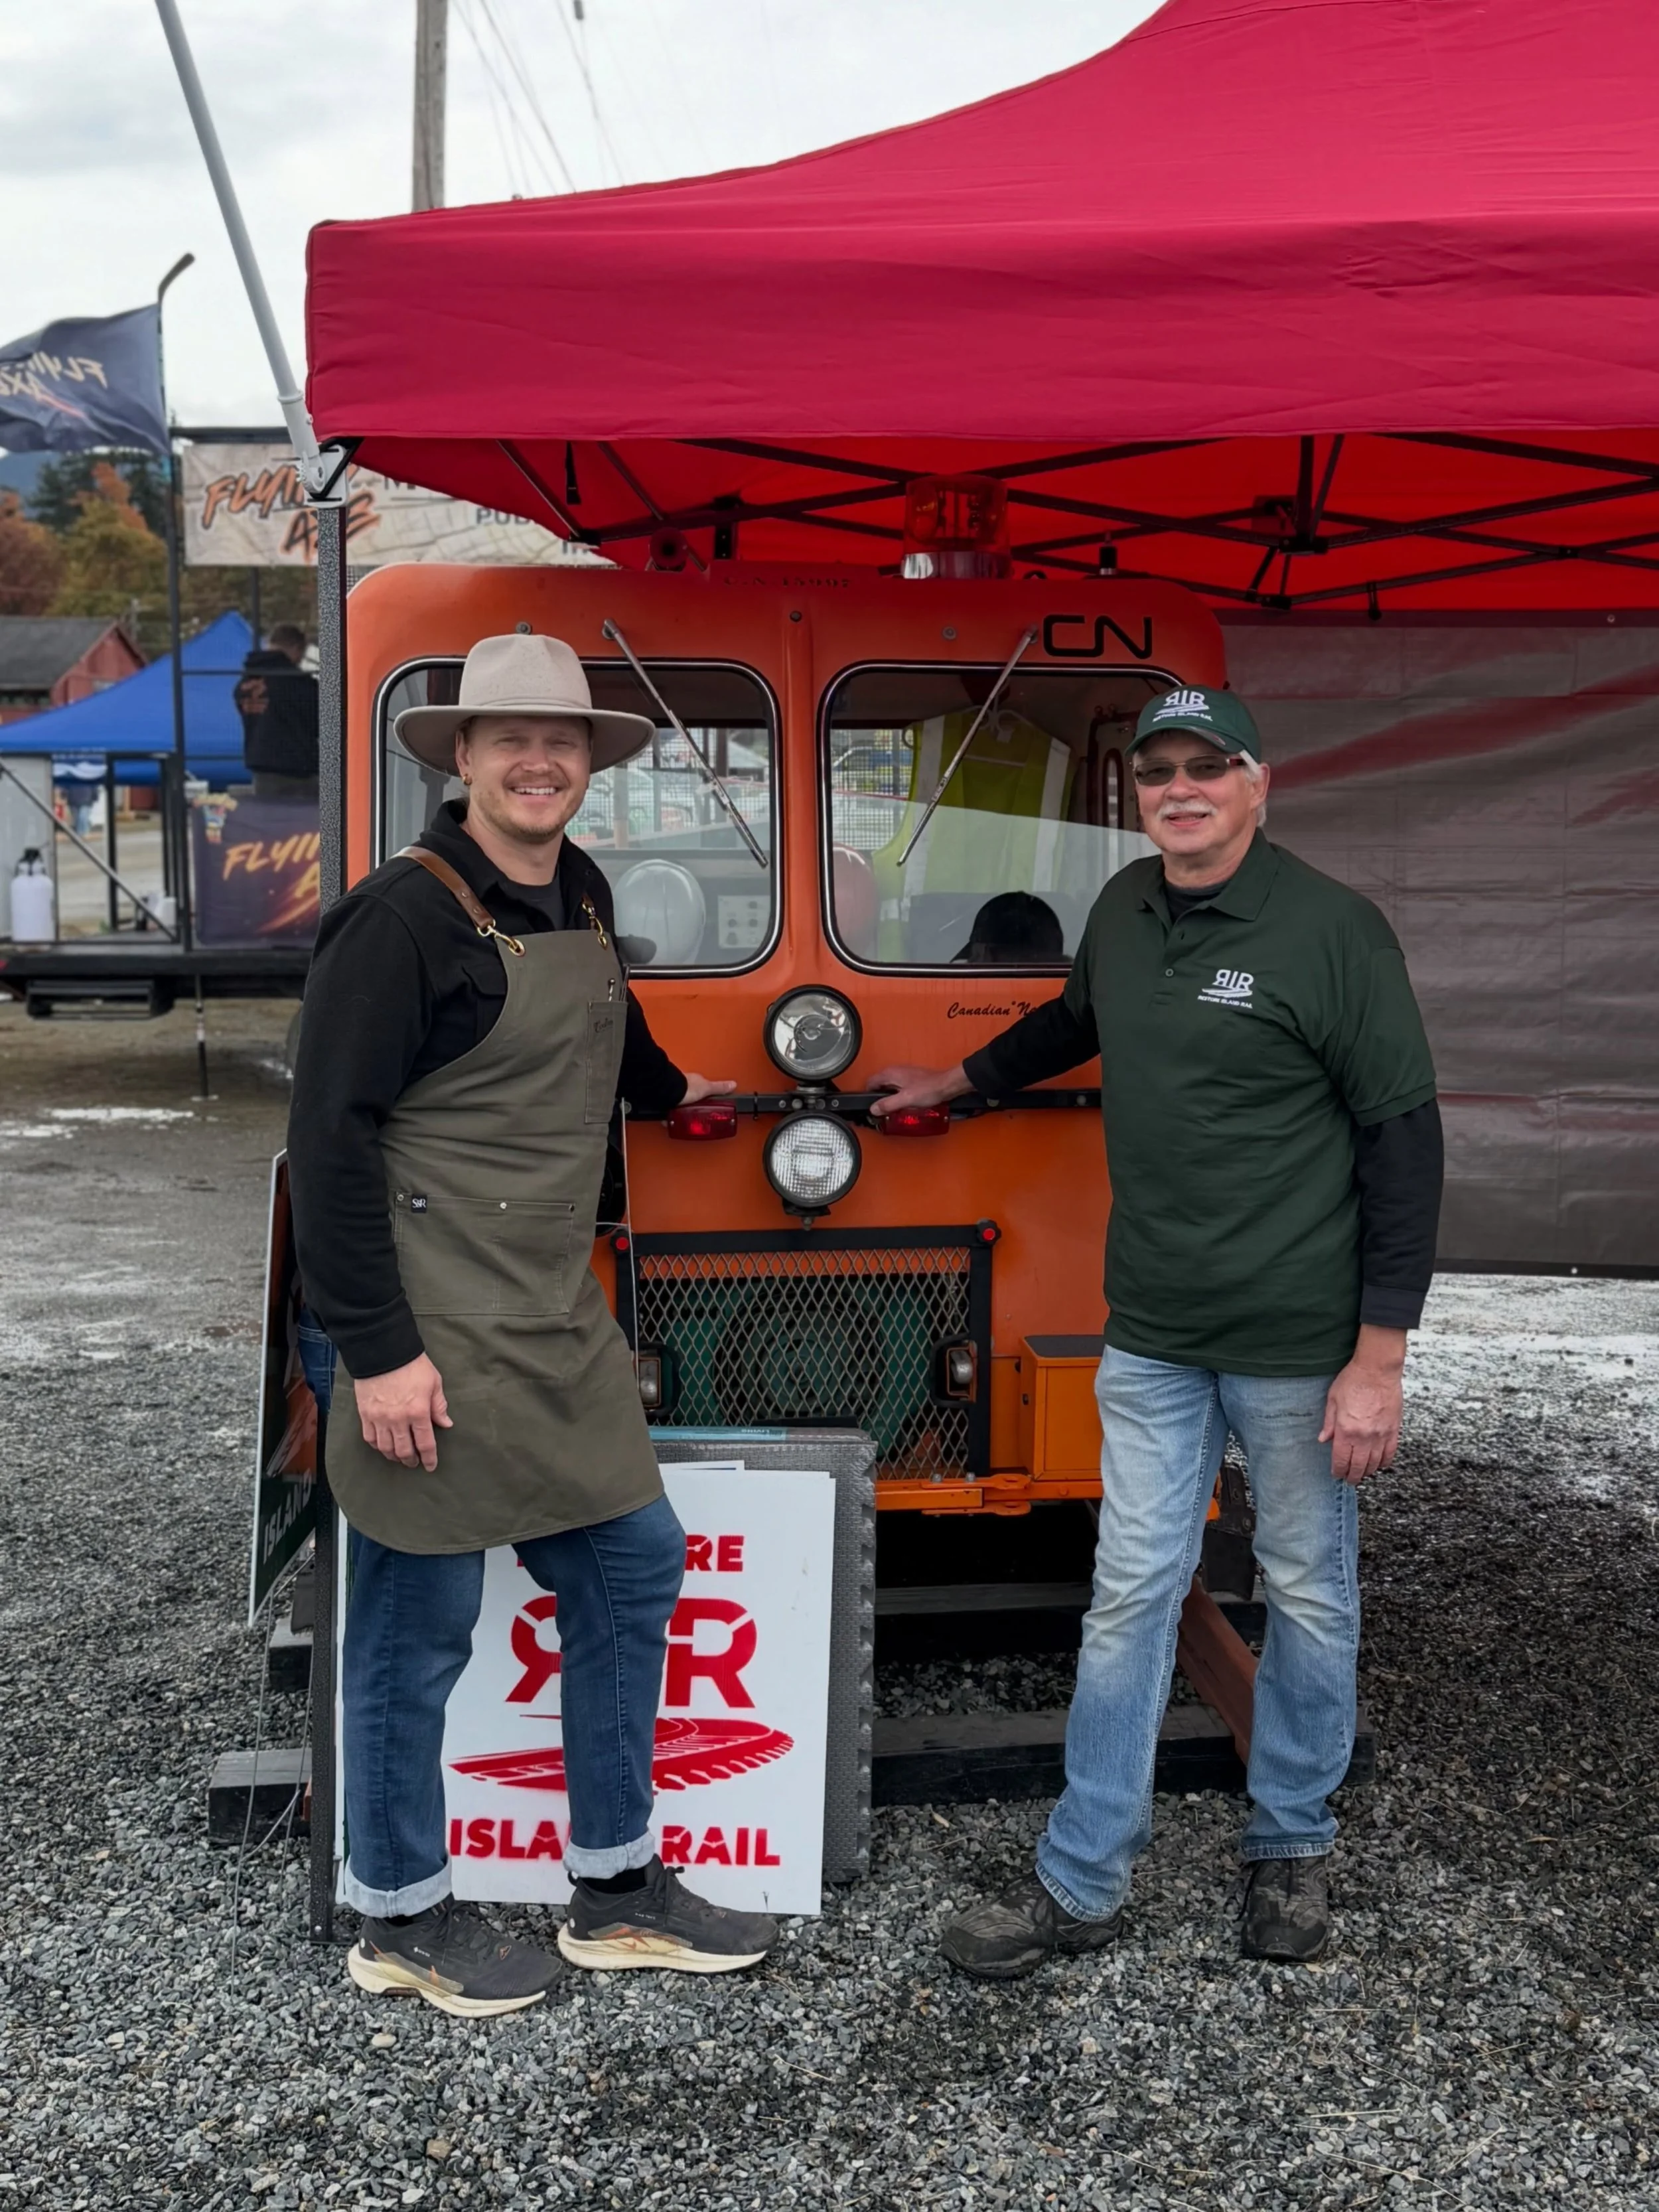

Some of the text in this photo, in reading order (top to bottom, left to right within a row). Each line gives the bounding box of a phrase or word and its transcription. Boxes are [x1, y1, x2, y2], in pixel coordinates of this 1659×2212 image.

[281, 490, 380, 561] AE
[1043, 615, 1153, 659] CN
[947, 1001, 1011, 1019] Canadian
[449, 1818, 780, 1866] ISLA RAIL
